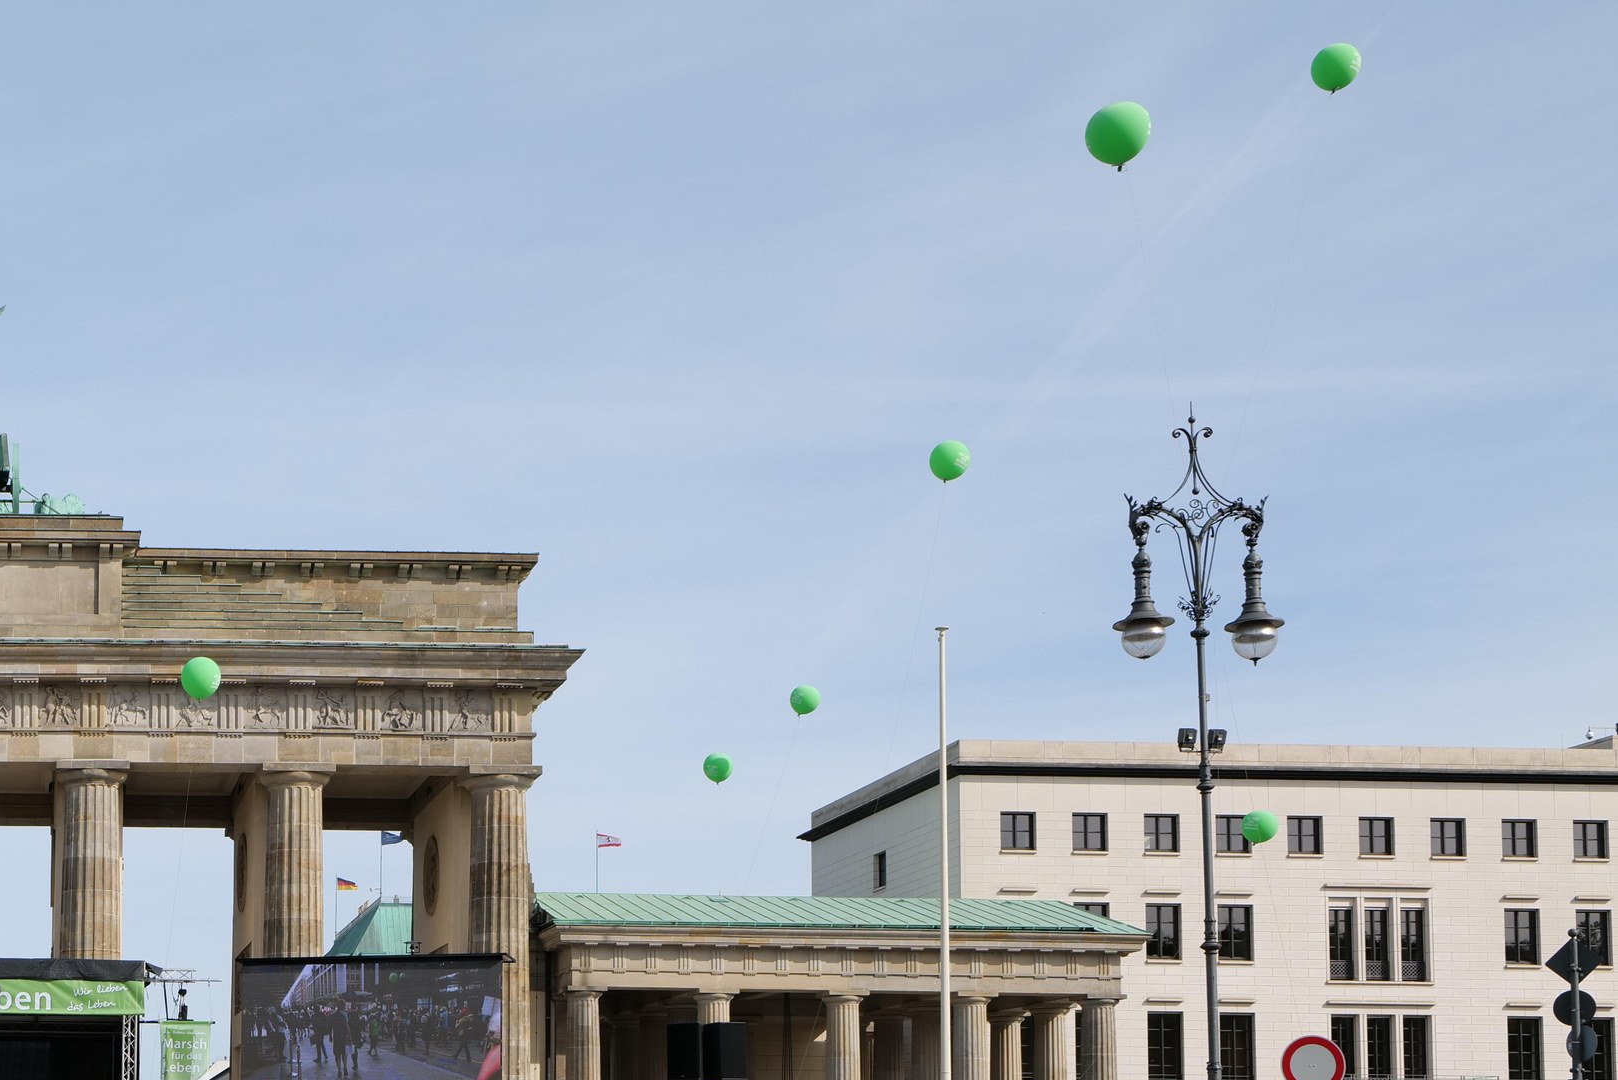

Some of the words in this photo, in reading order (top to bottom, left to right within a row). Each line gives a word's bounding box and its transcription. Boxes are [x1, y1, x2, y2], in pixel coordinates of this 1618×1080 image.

[73, 987, 93, 997] Wir
[97, 984, 129, 995] lieben
[67, 1000, 84, 1012] das
[87, 998, 117, 1010] Leben
[171, 1051, 185, 1060] für
